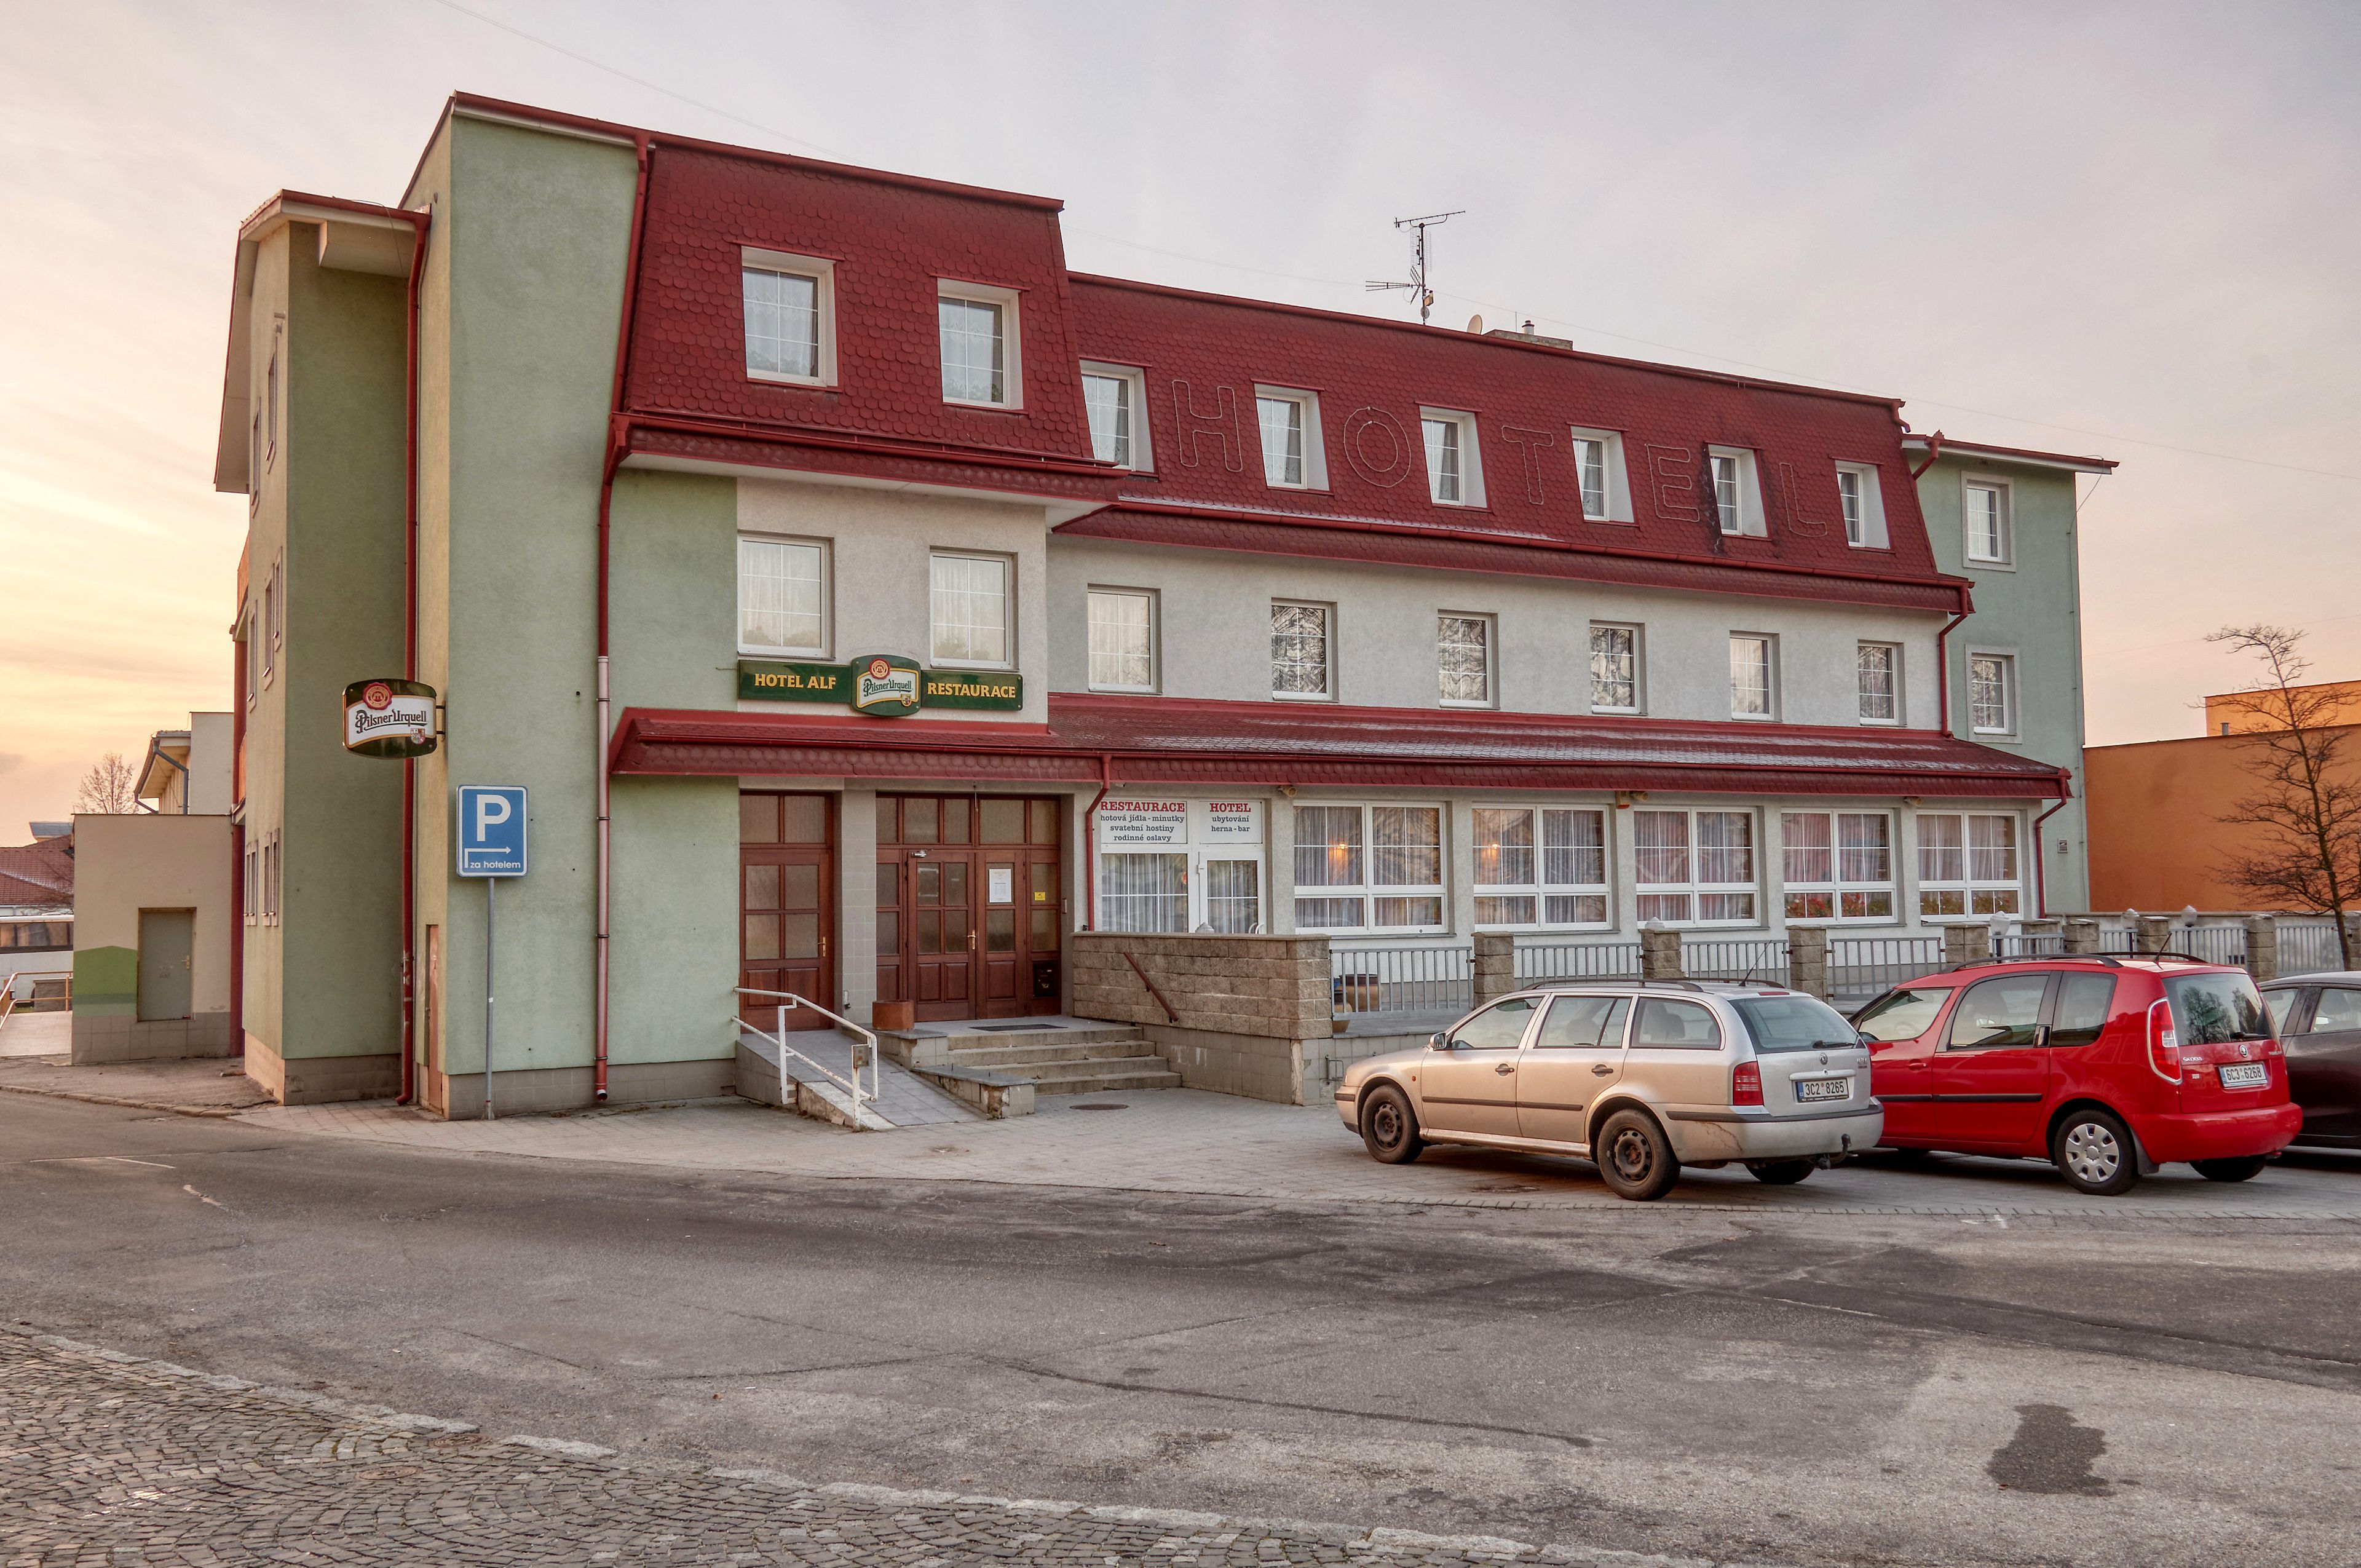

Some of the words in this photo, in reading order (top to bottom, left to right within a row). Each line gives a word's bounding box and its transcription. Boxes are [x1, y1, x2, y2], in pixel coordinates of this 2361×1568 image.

[1171, 378, 1828, 538] HOTEL
[754, 673, 804, 688] HOTEL
[807, 676, 836, 689] ALF
[863, 678, 890, 697] Pilsner
[888, 678, 912, 693] Urquell
[927, 682, 1016, 699] RESTAURACE
[355, 710, 393, 734] Pilsner
[392, 708, 427, 727] Urquell
[1101, 801, 1185, 812] RESTAURACE
[1209, 802, 1251, 812] HOTEL
[477, 794, 512, 842] P
[1128, 814, 1147, 823] jídla
[1152, 815, 1185, 823] minutky
[2226, 1068, 2240, 1081] 6C3
[2244, 1066, 2262, 1079] 6268
[1805, 1083, 1821, 1096] 3C2
[1825, 1081, 1845, 1094] 8265
